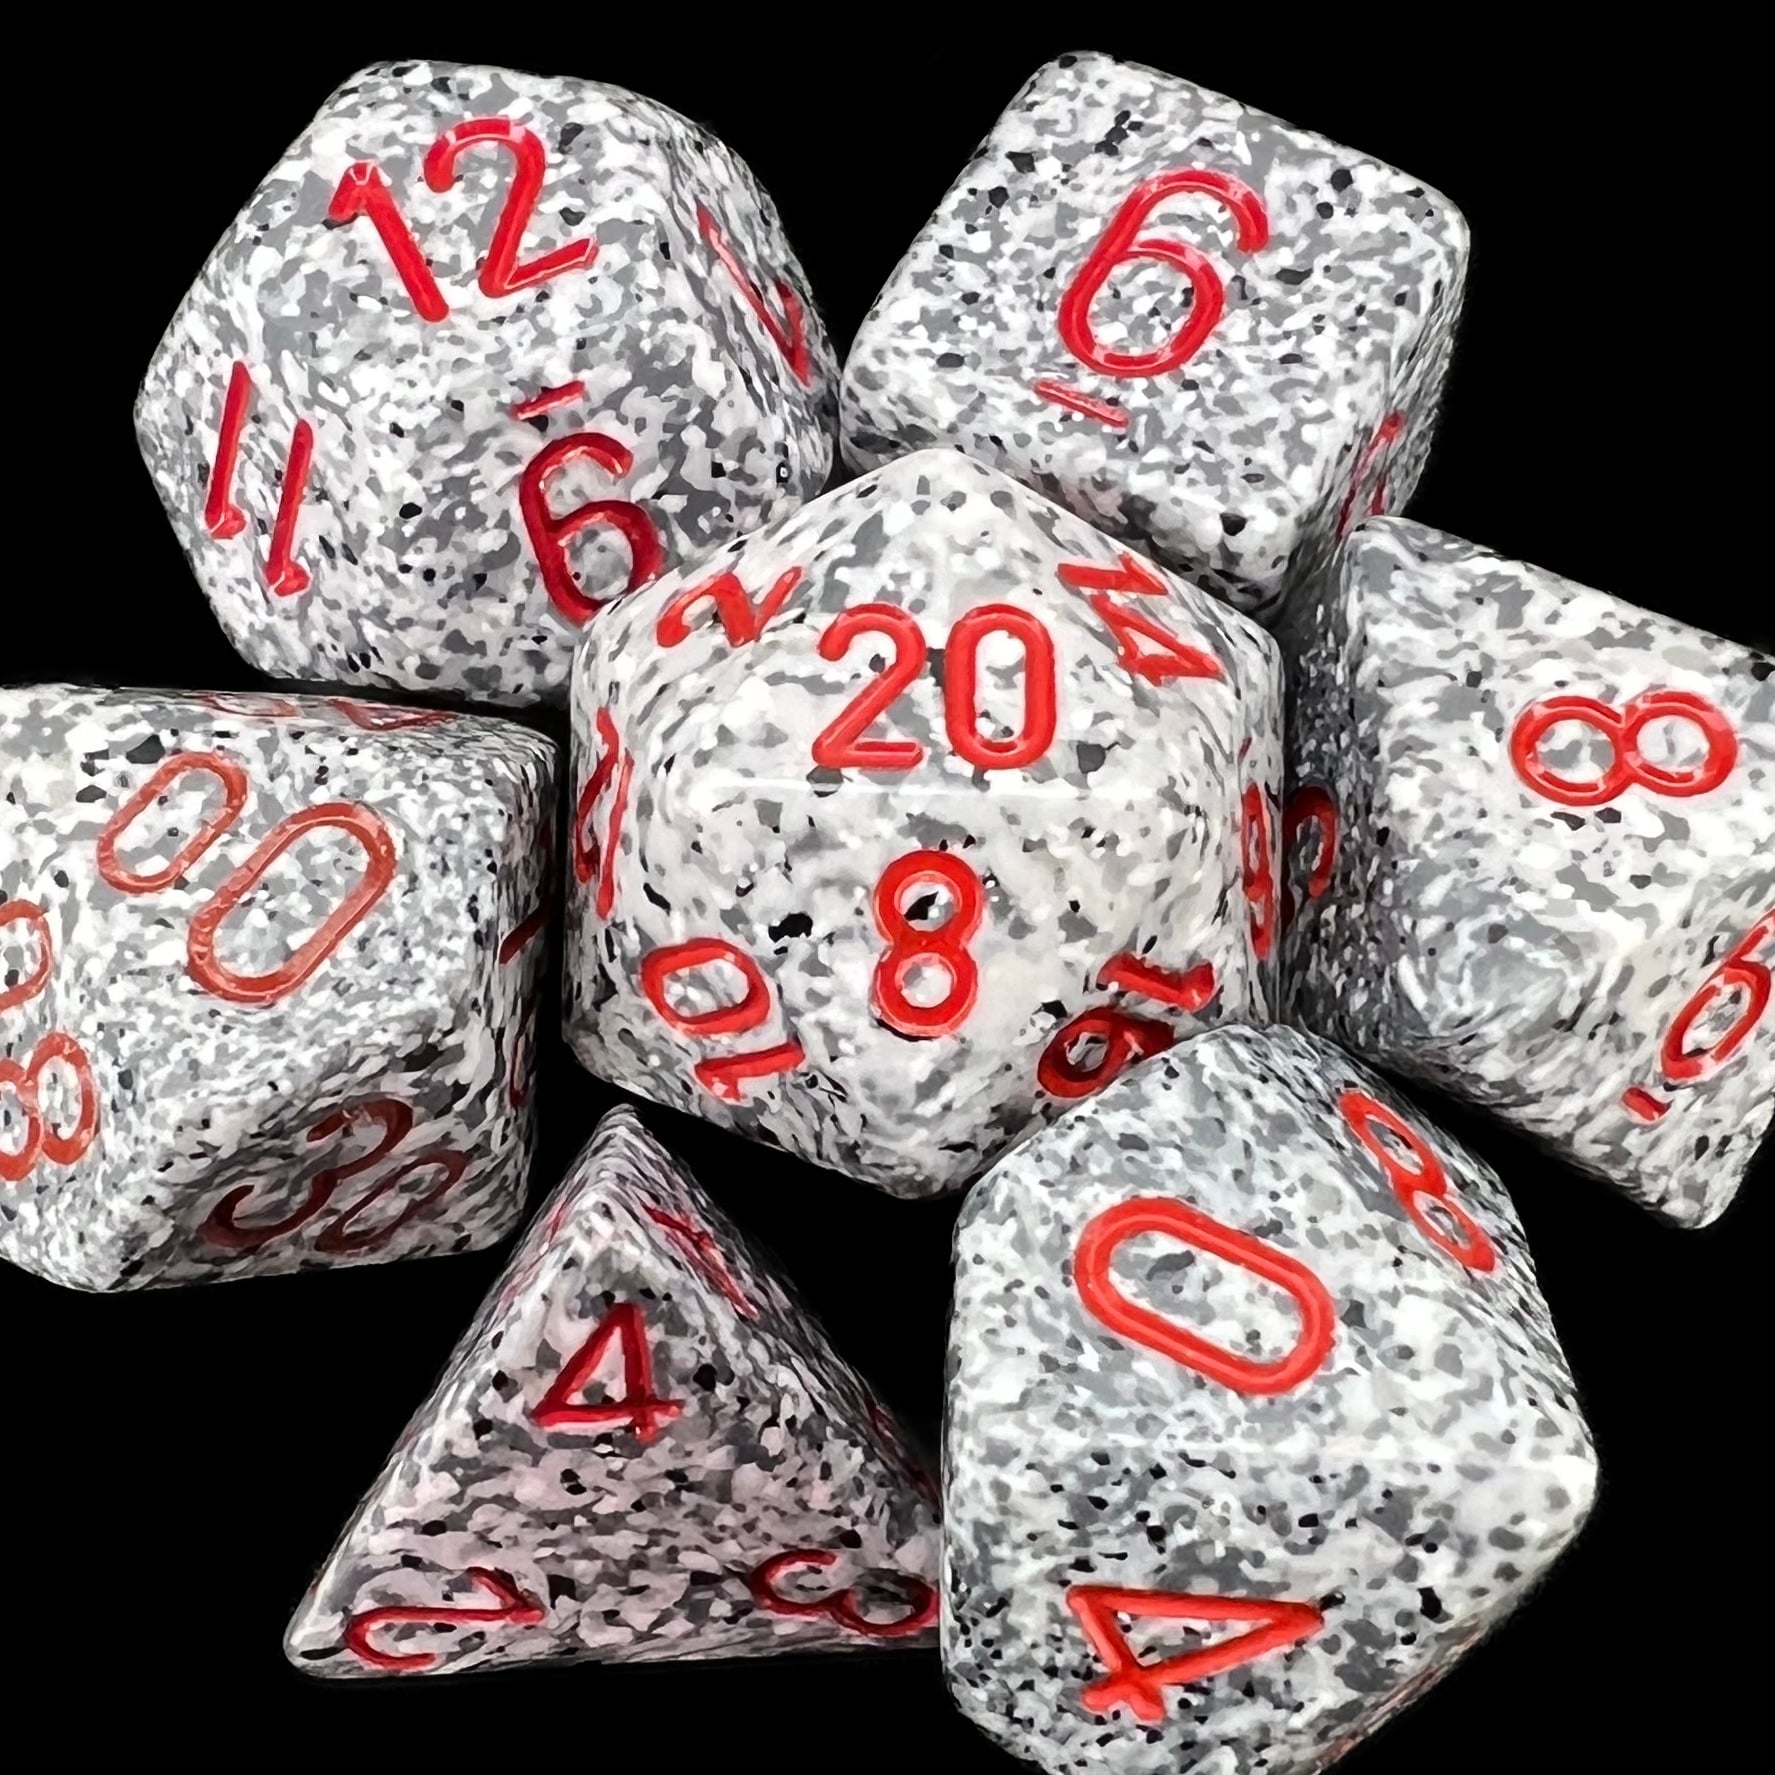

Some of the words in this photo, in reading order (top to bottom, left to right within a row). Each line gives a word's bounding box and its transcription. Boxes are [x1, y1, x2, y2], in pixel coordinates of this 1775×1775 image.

[328, 116, 599, 324] 12
[1057, 168, 1271, 380] 6
[204, 363, 316, 598] 11
[656, 566, 804, 648] 2
[812, 601, 1059, 772] 20
[1057, 553, 1223, 687] 14
[1510, 689, 1740, 807] 8
[98, 752, 396, 1004] 00
[871, 848, 986, 1039] 8
[640, 937, 806, 1102] 10
[1338, 1090, 1499, 1275] 8
[531, 1303, 684, 1444] 4
[1071, 1197, 1337, 1397] 0
[1065, 1584, 1325, 1724] 4
